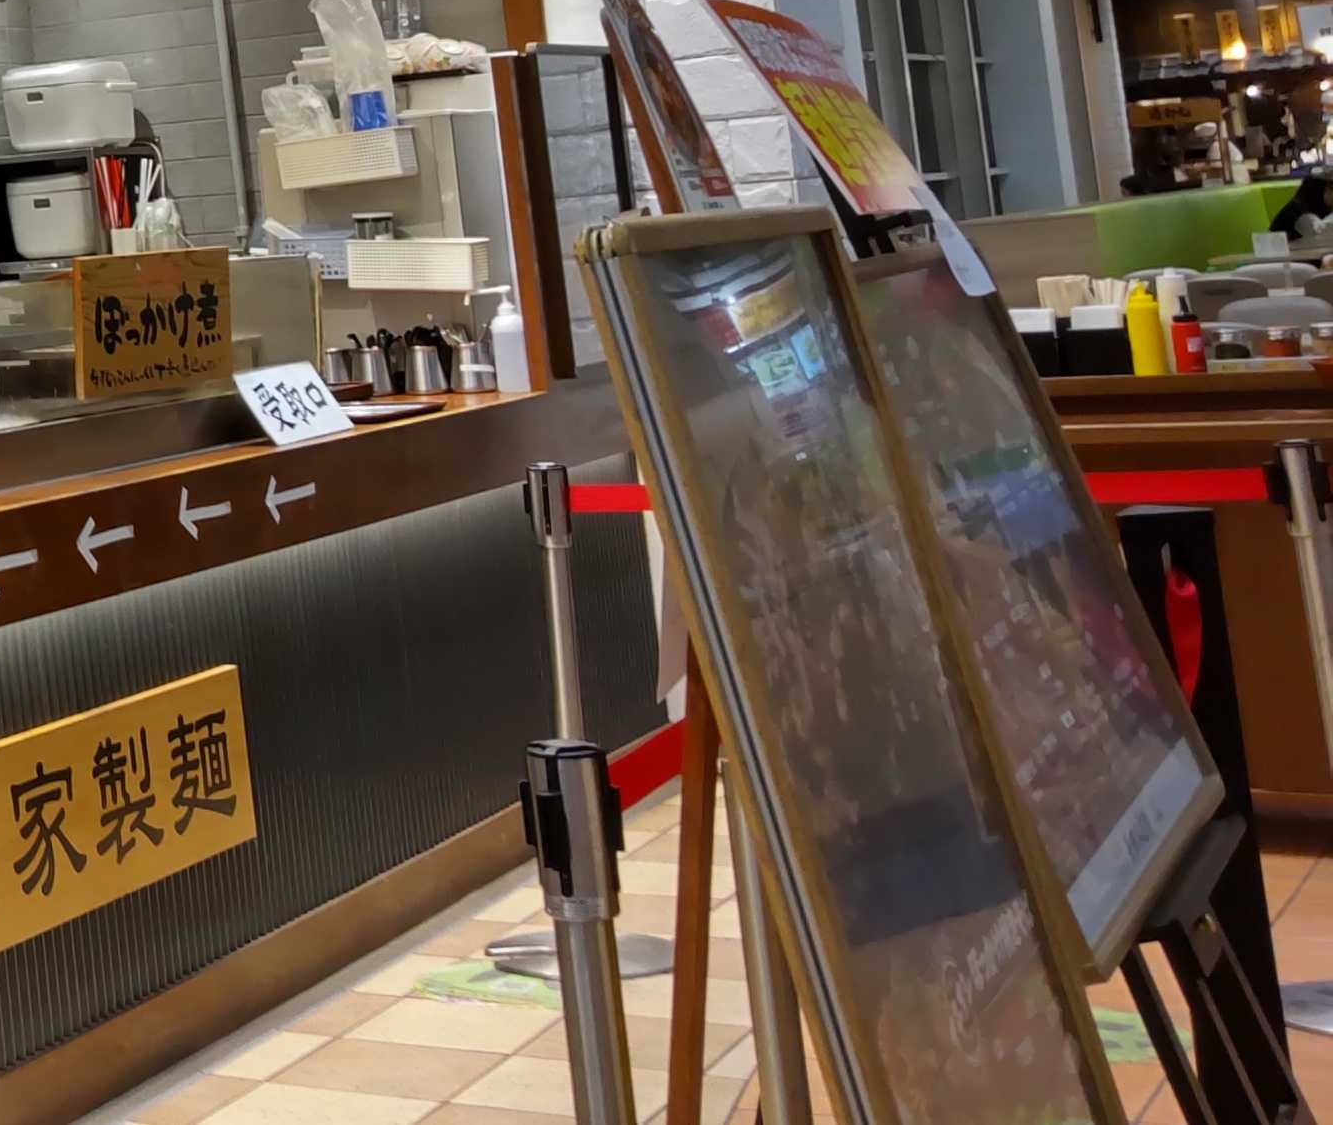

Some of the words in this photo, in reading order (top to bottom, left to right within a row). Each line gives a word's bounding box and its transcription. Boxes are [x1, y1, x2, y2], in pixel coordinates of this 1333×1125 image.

[94, 279, 221, 355] ぼっかけ煮
[252, 381, 328, 432] 受取口
